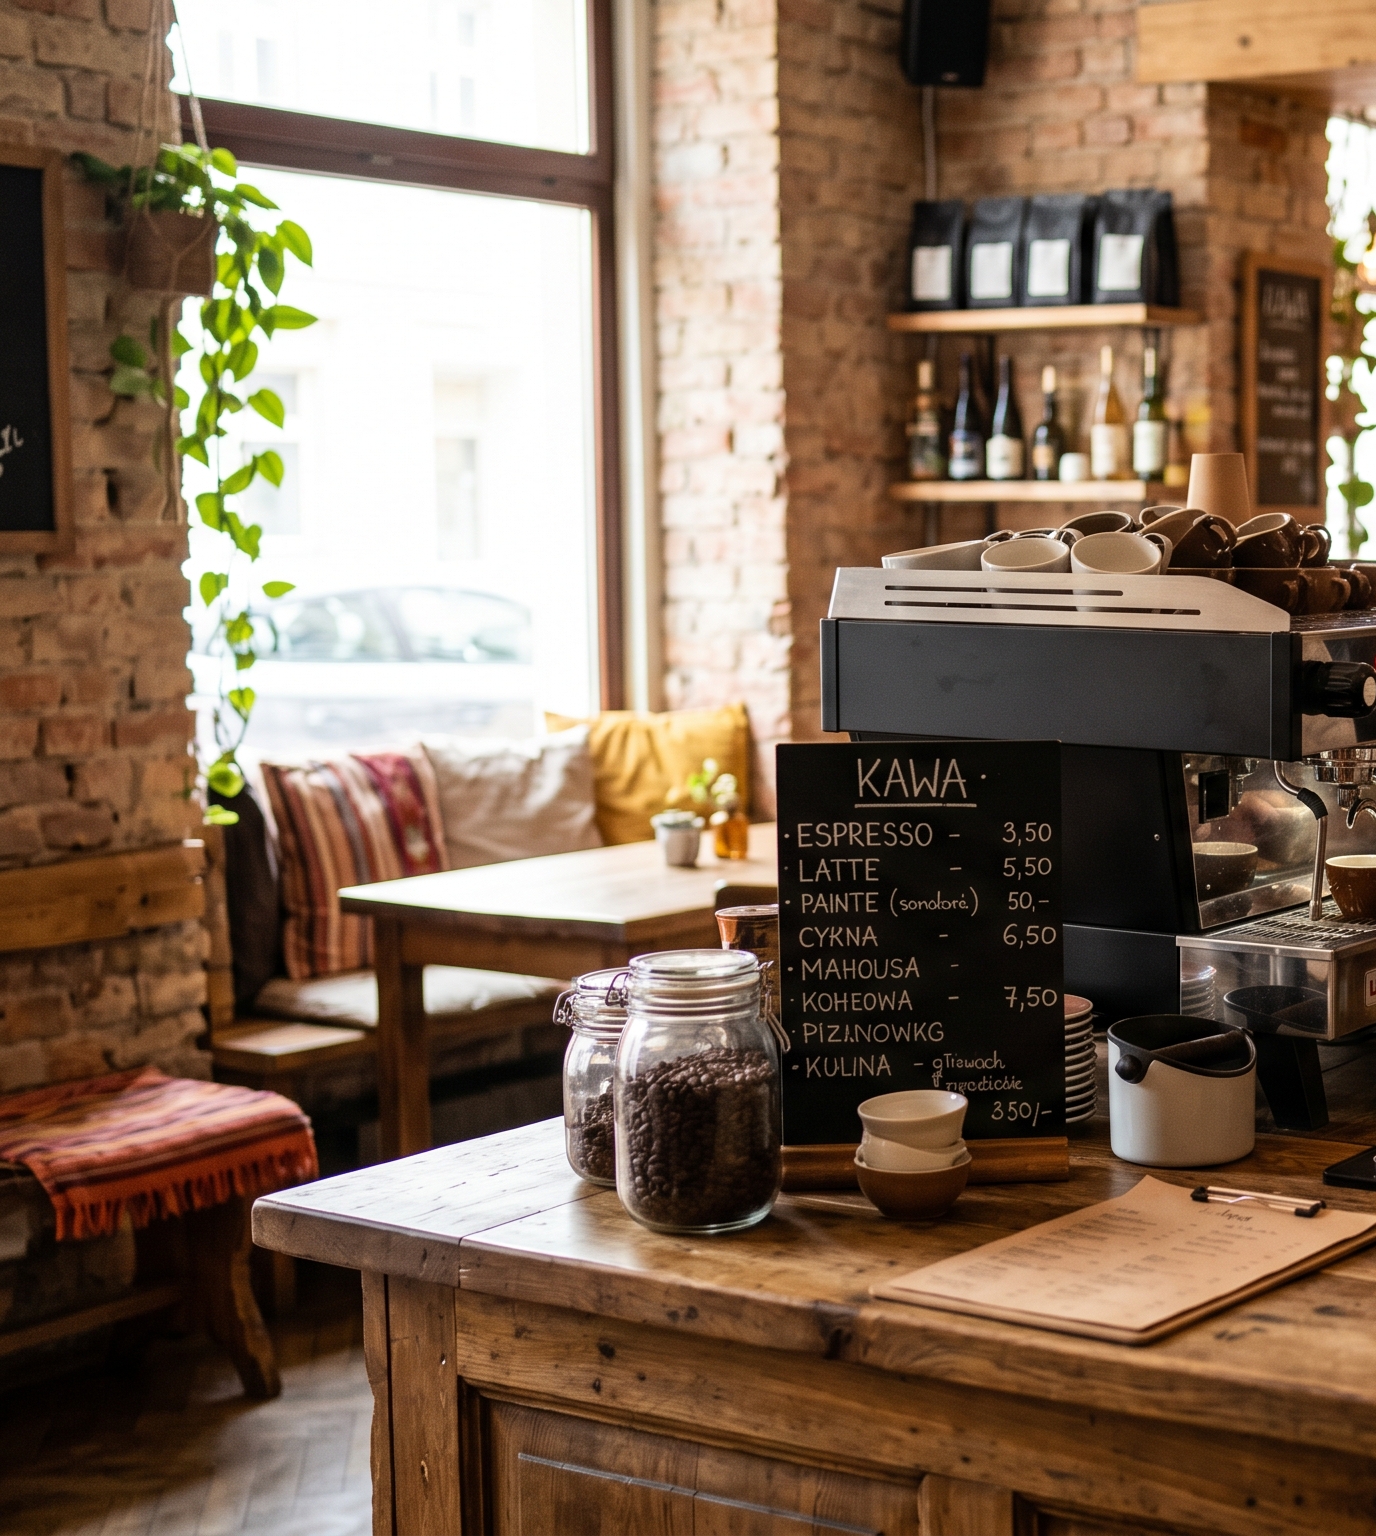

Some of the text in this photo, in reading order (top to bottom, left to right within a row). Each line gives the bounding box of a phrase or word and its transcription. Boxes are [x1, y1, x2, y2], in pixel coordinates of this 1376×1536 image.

[857, 758, 967, 798] KAWA
[797, 821, 933, 848] ESPRESSO
[1002, 821, 1052, 847] 3,50
[799, 858, 880, 883] LATTE
[1002, 857, 1052, 881] 5,50
[801, 892, 879, 914] PAINTE
[798, 926, 879, 948] CYKNA
[1002, 923, 1057, 950] 6,50
[801, 956, 920, 981] MAHOUSA
[802, 989, 913, 1013] KOHEOWA
[1003, 986, 1058, 1013] 7,50
[805, 1053, 892, 1078] KULINA
